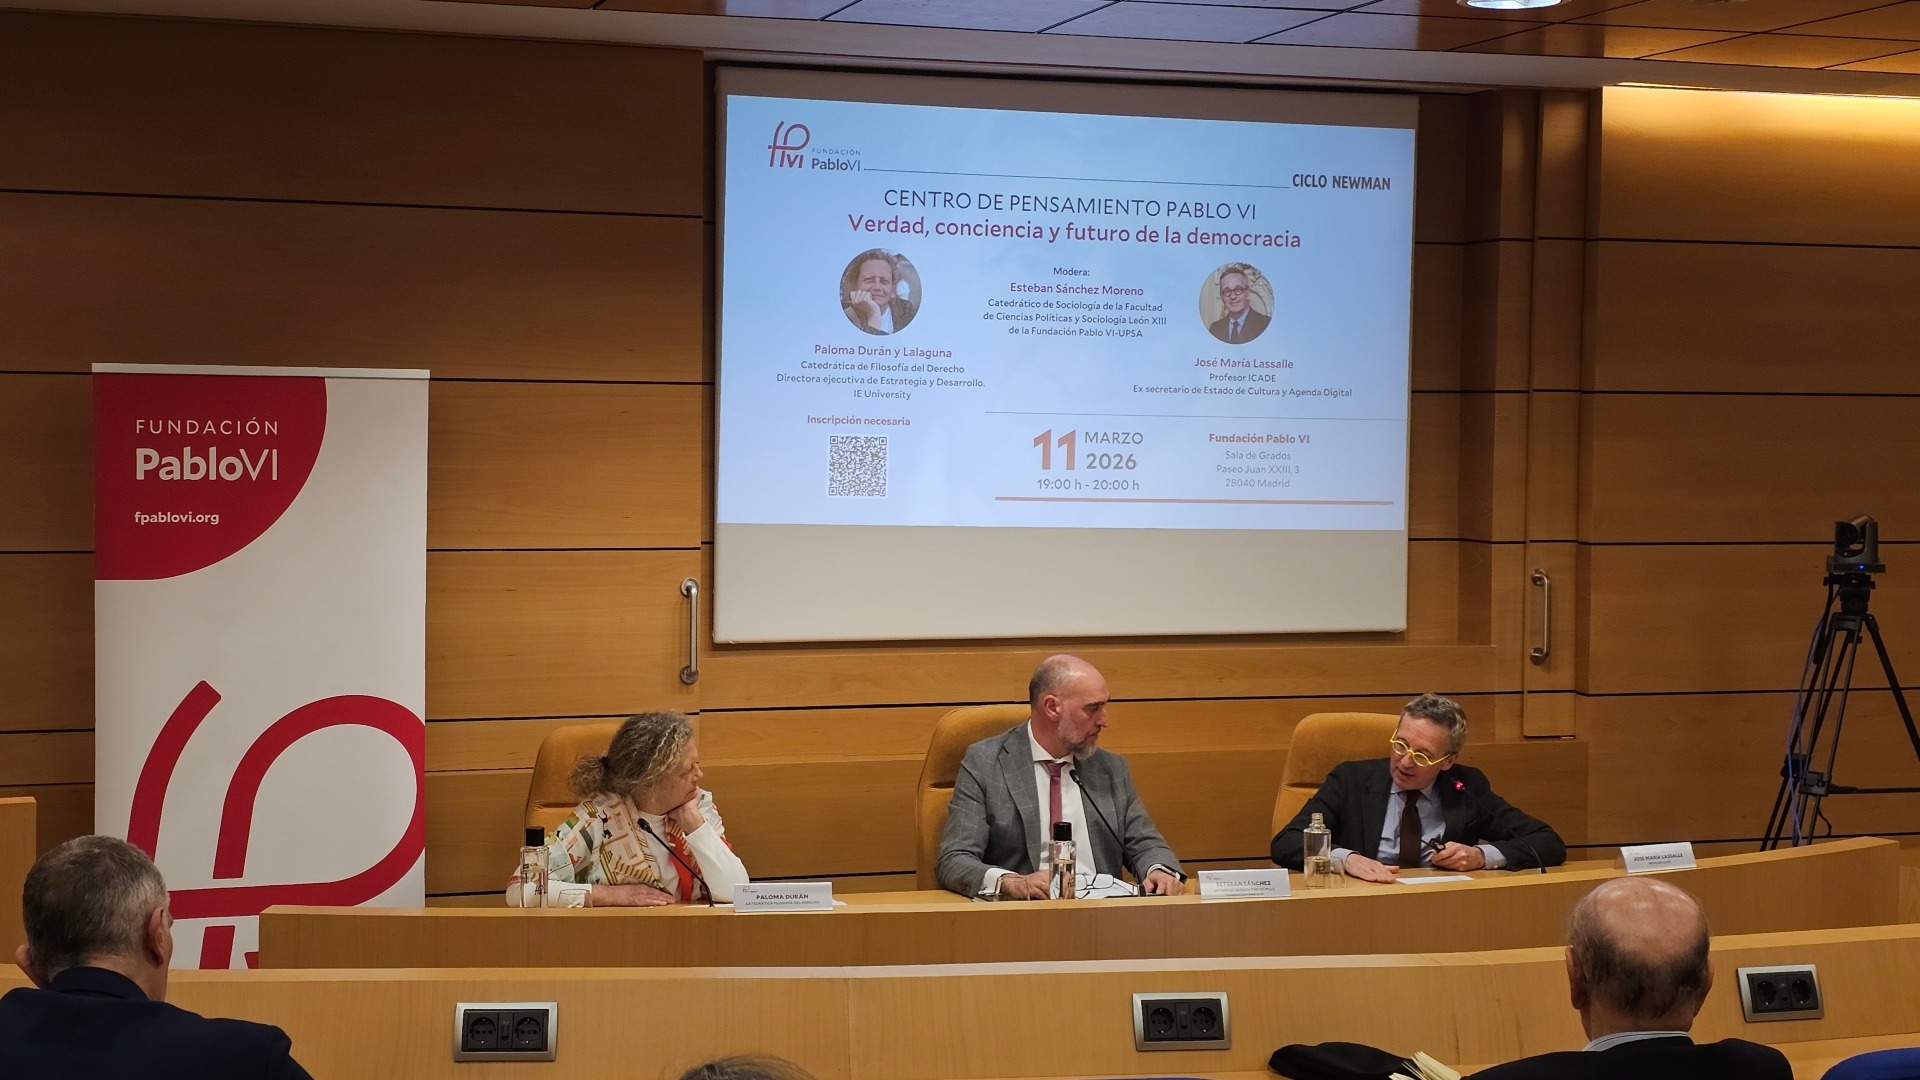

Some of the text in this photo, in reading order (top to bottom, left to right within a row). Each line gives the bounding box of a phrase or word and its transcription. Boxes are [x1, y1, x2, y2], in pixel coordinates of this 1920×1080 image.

[812, 147, 861, 155] FUNDACIÓN
[811, 158, 861, 172] PabloVI
[1292, 173, 1391, 190] CICLO NEWMAN
[884, 189, 1256, 220] CENTRO DE PENSAMIENTO PABLO VI
[848, 214, 1301, 248] Verdad, conciencia y futuro de la democracia
[1053, 267, 1090, 276] Modera:
[1010, 283, 1144, 296] Esteban Sánchez Moreno
[988, 299, 1163, 311] Catedrático de Sociología de la Facultad
[983, 312, 994, 320] de
[996, 313, 1033, 322] Ciencias
[1035, 314, 1072, 323] Políticas
[1082, 315, 1127, 325] Sociología
[1129, 316, 1150, 325] León
[1151, 317, 1167, 325] XIII
[1009, 326, 1143, 338] de la Fundación Pablo VI-UPSA
[814, 344, 952, 358] Paloma Durán y Lalaguna
[801, 361, 965, 373] Catedrática de Filosofía del Derecho
[1195, 357, 1294, 369] José María Lassalle
[777, 374, 985, 387] Directora ejecutiva de Estrategia y Desarrollo.
[1210, 373, 1276, 382] Profesor ICADE
[854, 390, 911, 400] IE University
[1145, 385, 1189, 394] secretario
[1192, 386, 1202, 394] de
[1204, 387, 1233, 395] Estado
[1236, 387, 1246, 395] de
[1248, 387, 1279, 396] Cultura
[1289, 388, 1321, 398] Agenda
[1324, 388, 1352, 398] Digital
[136, 417, 278, 435] FUNDACIÓN
[807, 415, 911, 426] Inscripción necesaria
[1085, 432, 1143, 444] MARZO
[1209, 433, 1310, 444] Fundación Pablo VI
[1034, 429, 1076, 470] 11
[1086, 453, 1137, 470] 2026
[1225, 451, 1291, 461] Sala de Grados
[136, 446, 278, 481] PabloVI
[1217, 465, 1300, 475] Paseo Juan XXIII, 3
[1038, 479, 1071, 489] 19:00
[1075, 479, 1081, 490] h
[1093, 480, 1129, 490] 20:00
[1133, 480, 1140, 490] h
[1226, 479, 1290, 488] 28040 Madrid
[134, 511, 220, 525] fpablovi.org
